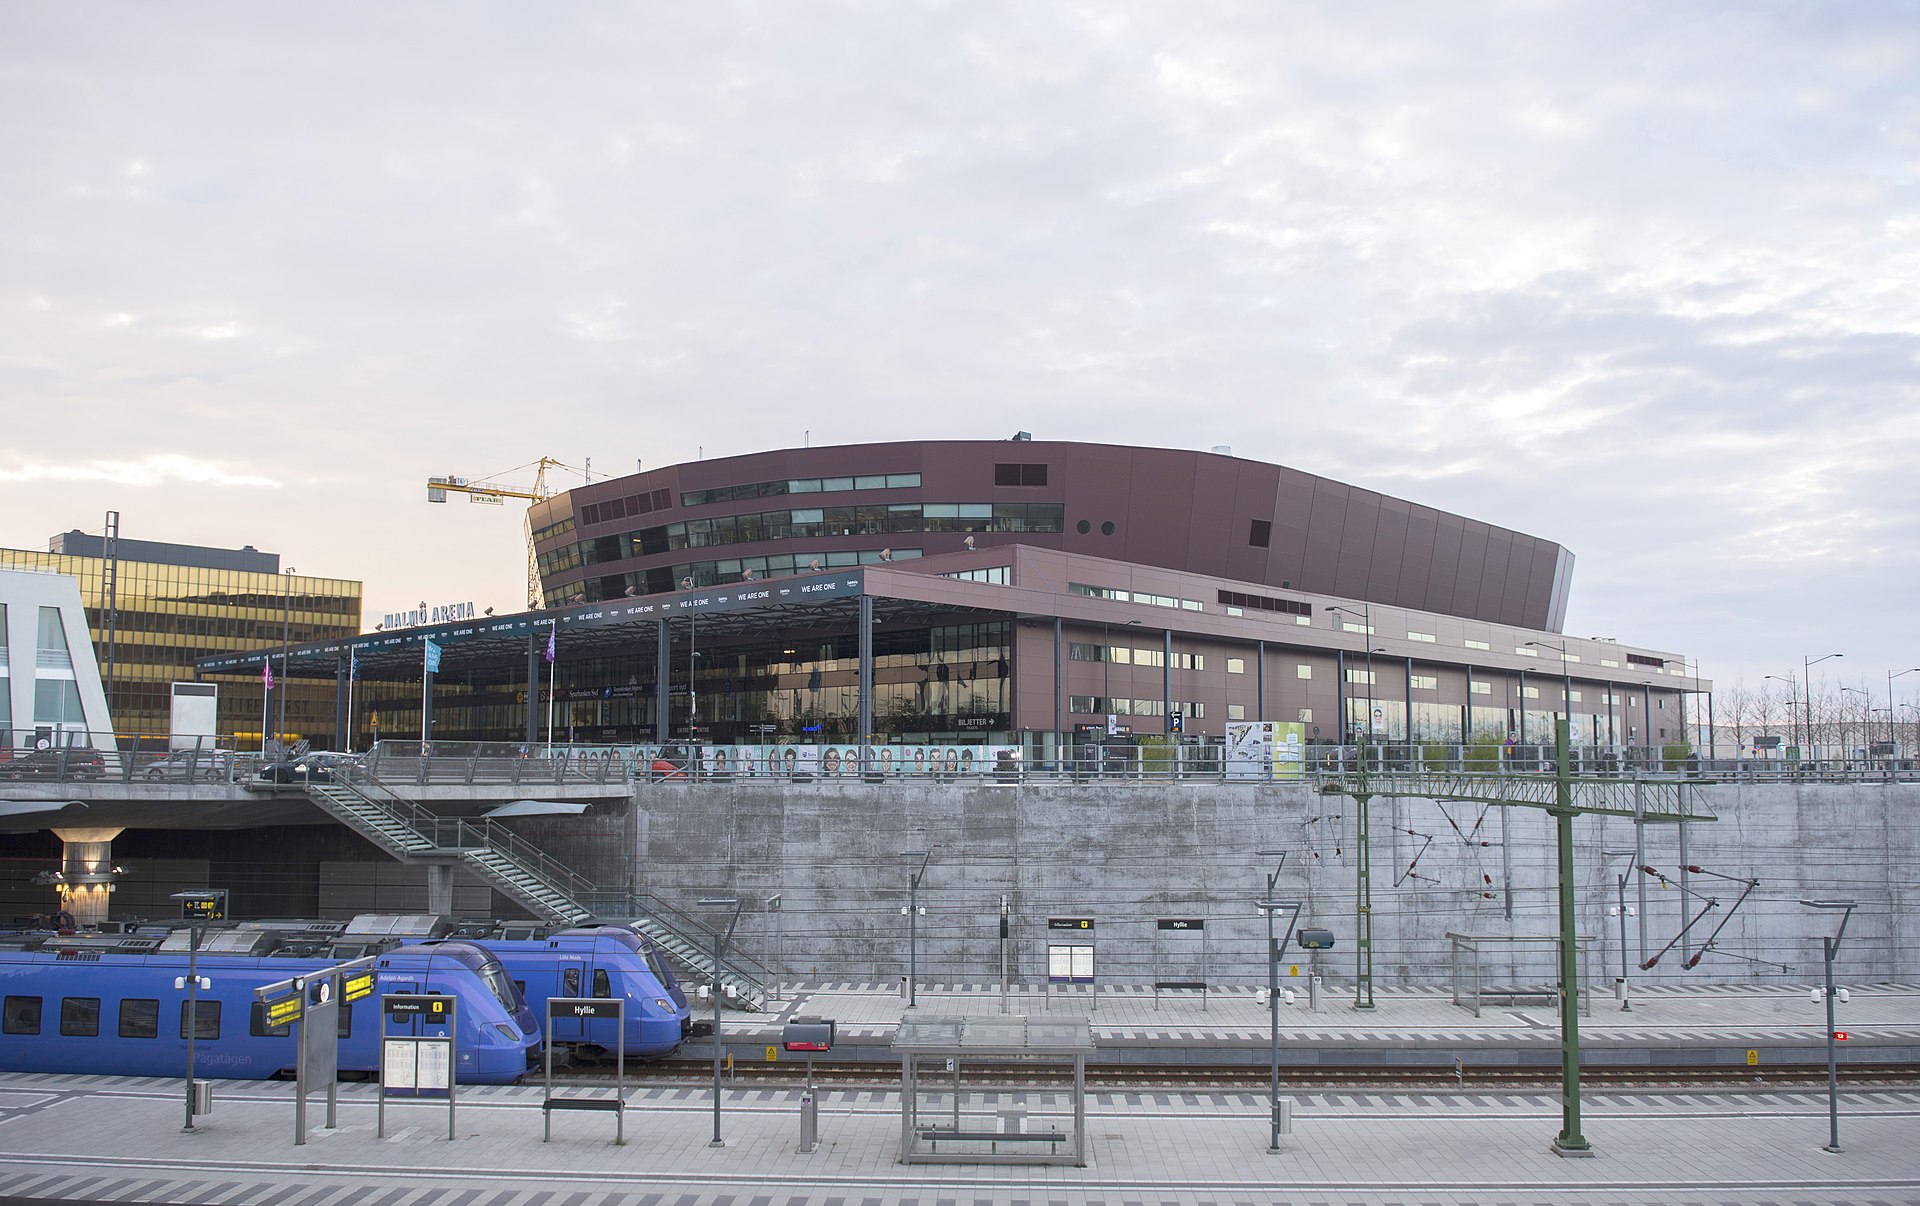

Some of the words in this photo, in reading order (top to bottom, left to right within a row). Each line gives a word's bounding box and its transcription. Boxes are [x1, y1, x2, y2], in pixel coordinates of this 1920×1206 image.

[811, 584, 822, 592] ARE
[824, 582, 836, 590] ONE
[384, 601, 427, 628] MALMÖ
[432, 602, 474, 622] ARENA
[1174, 718, 1179, 727] P
[574, 1006, 595, 1016] Hyllie
[194, 1052, 252, 1065] Pågatågen
